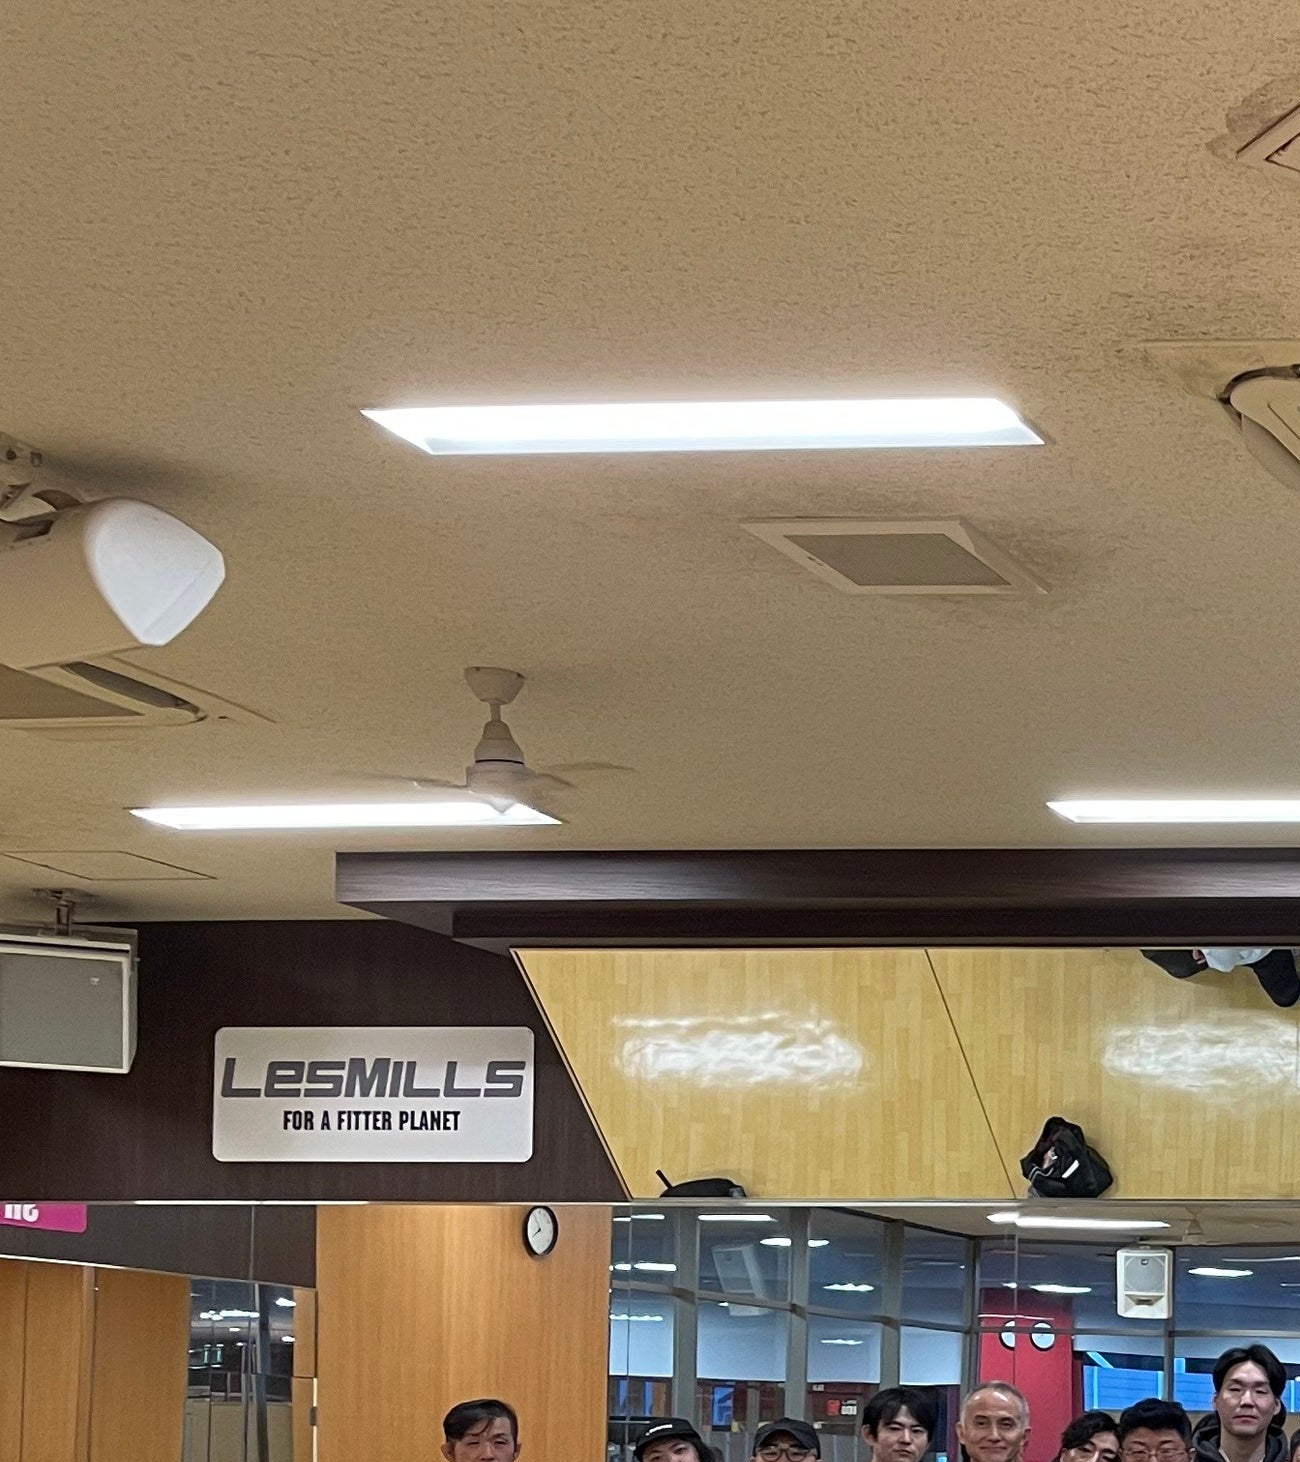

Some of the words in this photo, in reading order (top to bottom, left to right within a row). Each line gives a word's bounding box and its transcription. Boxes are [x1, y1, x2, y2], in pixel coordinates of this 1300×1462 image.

[283, 1110, 314, 1131] FOR
[320, 1110, 331, 1131] A
[337, 1110, 392, 1131] FITTER
[398, 1110, 461, 1131] PLANET
